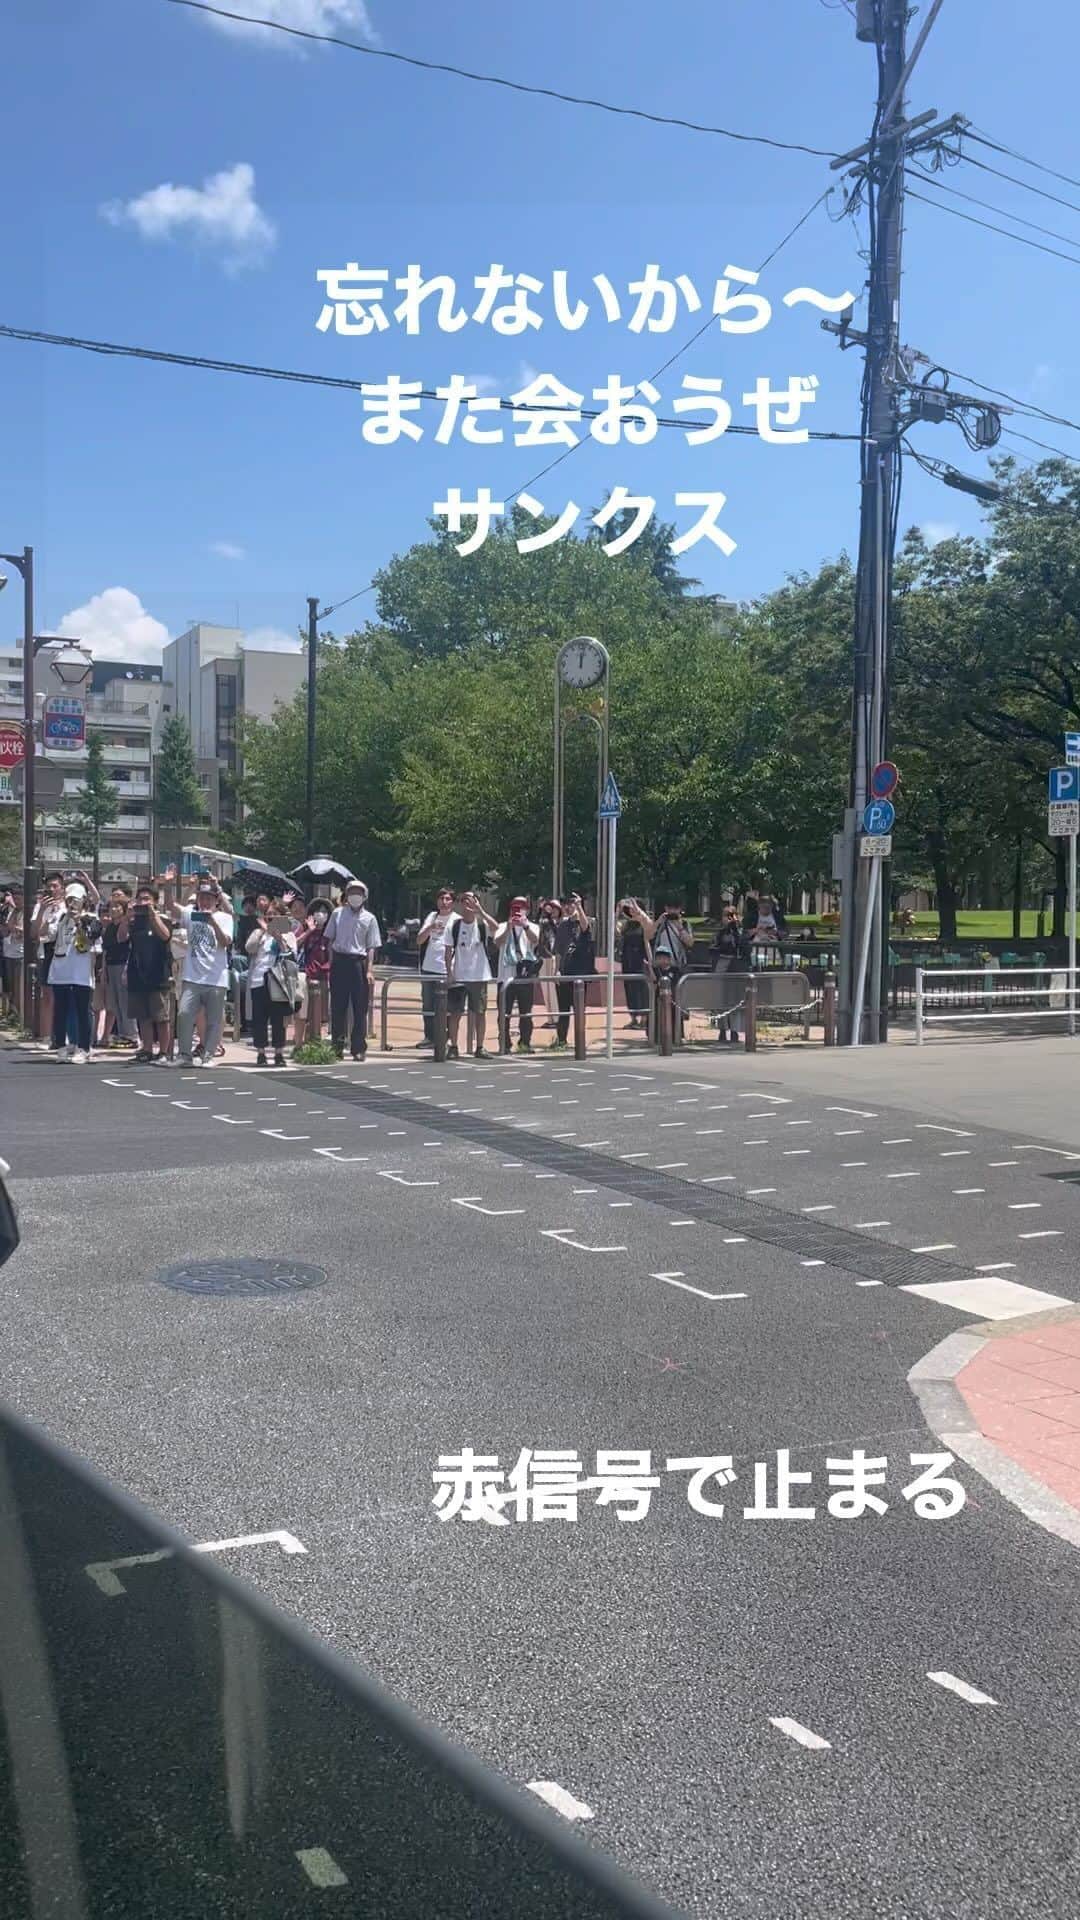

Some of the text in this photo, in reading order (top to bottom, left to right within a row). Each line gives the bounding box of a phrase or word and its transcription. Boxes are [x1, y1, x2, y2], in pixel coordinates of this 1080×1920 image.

[0, 741, 24, 755] 火栓
[1057, 771, 1073, 797] P
[869, 807, 881, 830] P
